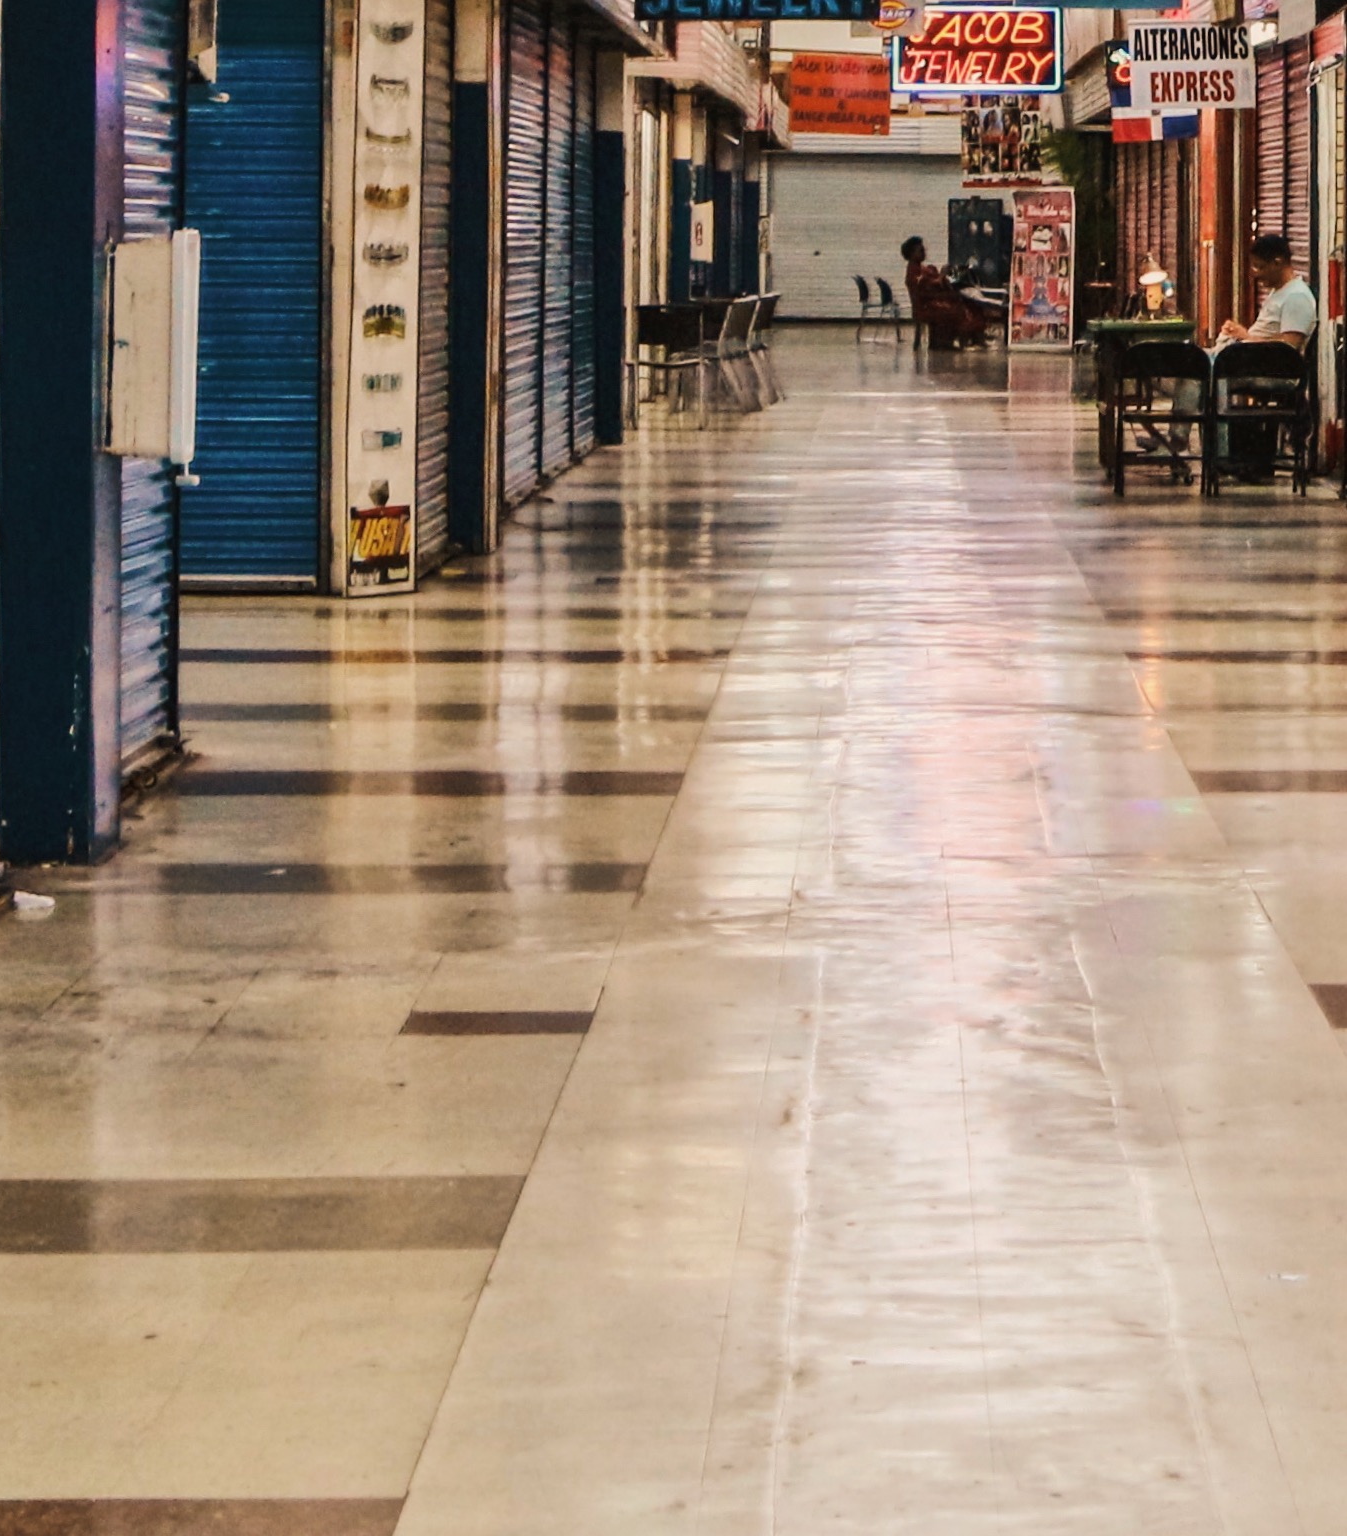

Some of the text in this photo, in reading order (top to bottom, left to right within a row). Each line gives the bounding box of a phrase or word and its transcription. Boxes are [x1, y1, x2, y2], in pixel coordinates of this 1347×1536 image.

[909, 13, 1044, 45] JACOB
[1133, 26, 1249, 62] ALTERACIONES
[901, 50, 1054, 84] JEWELRY
[1150, 70, 1236, 103] EXPRESS
